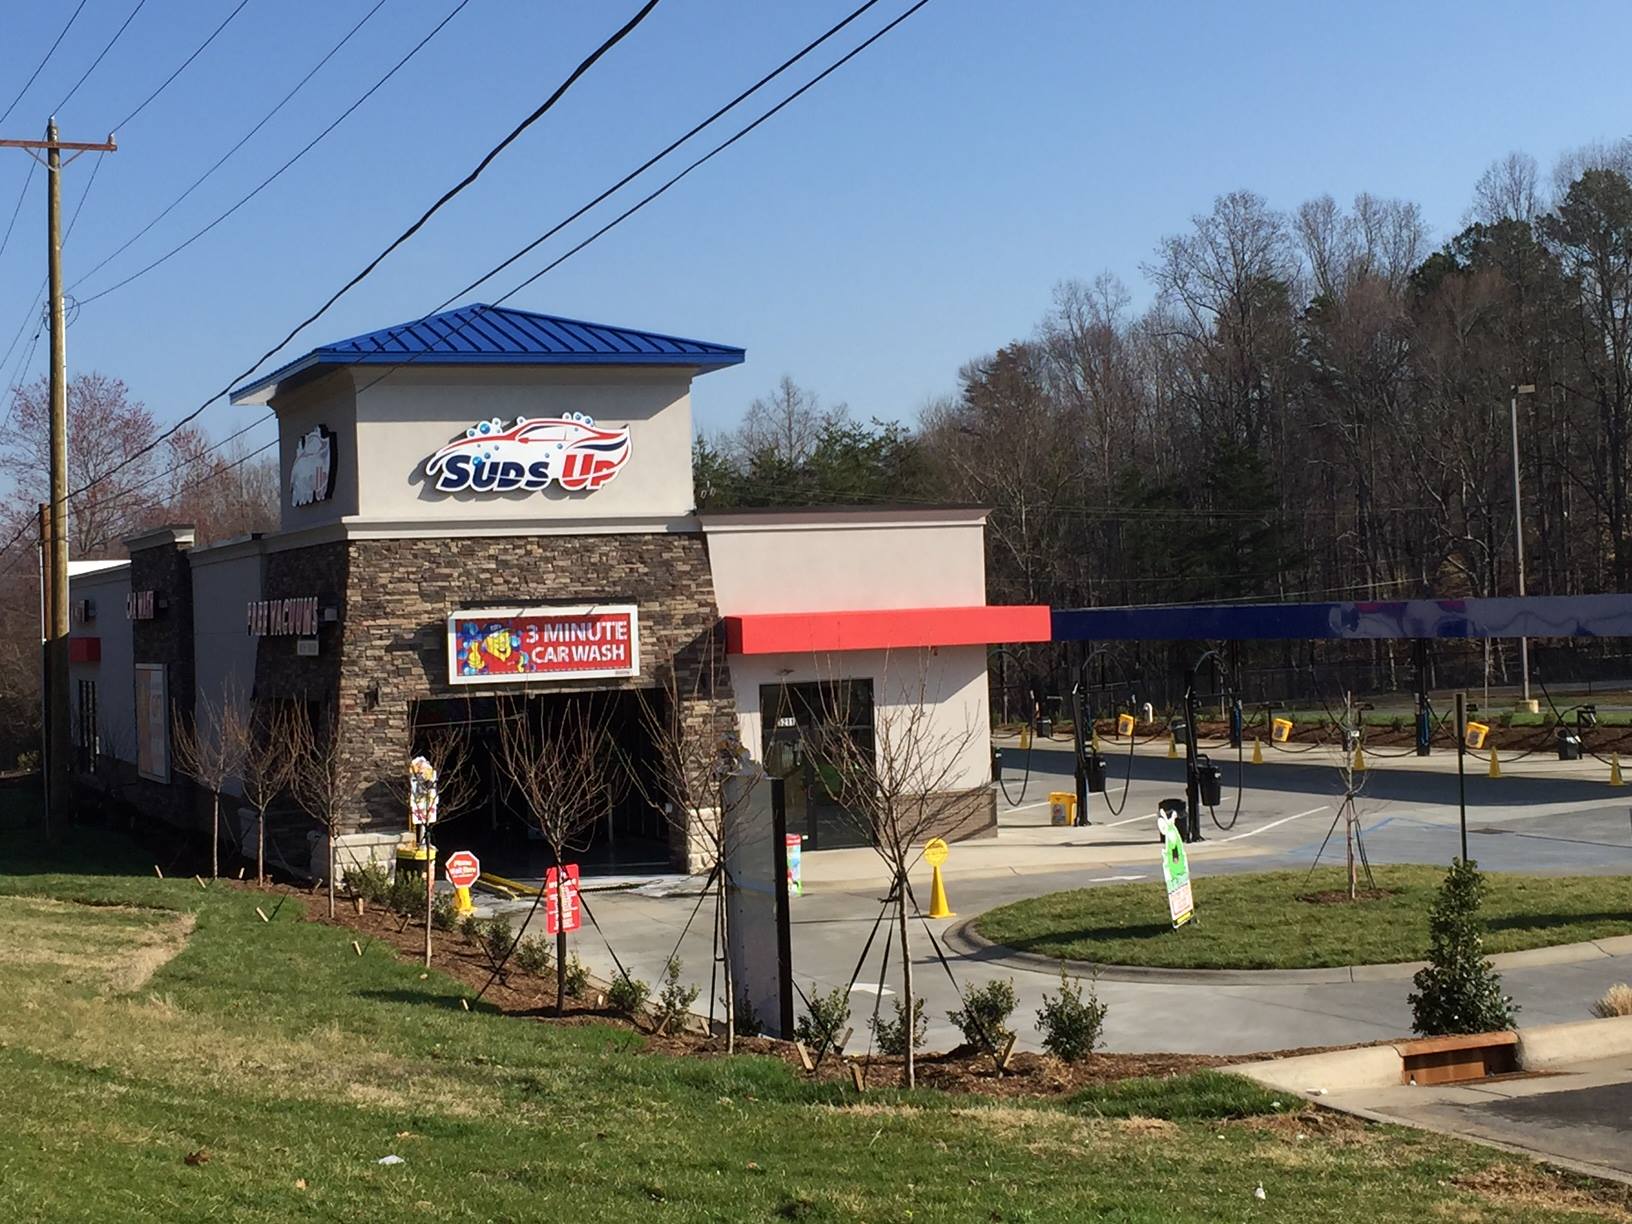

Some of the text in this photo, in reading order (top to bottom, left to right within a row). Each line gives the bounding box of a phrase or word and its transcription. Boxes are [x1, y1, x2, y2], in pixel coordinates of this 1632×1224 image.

[440, 453, 617, 489] SUDS UP
[526, 621, 628, 644] 3 MINUTE
[531, 644, 625, 664] CAR WASH
